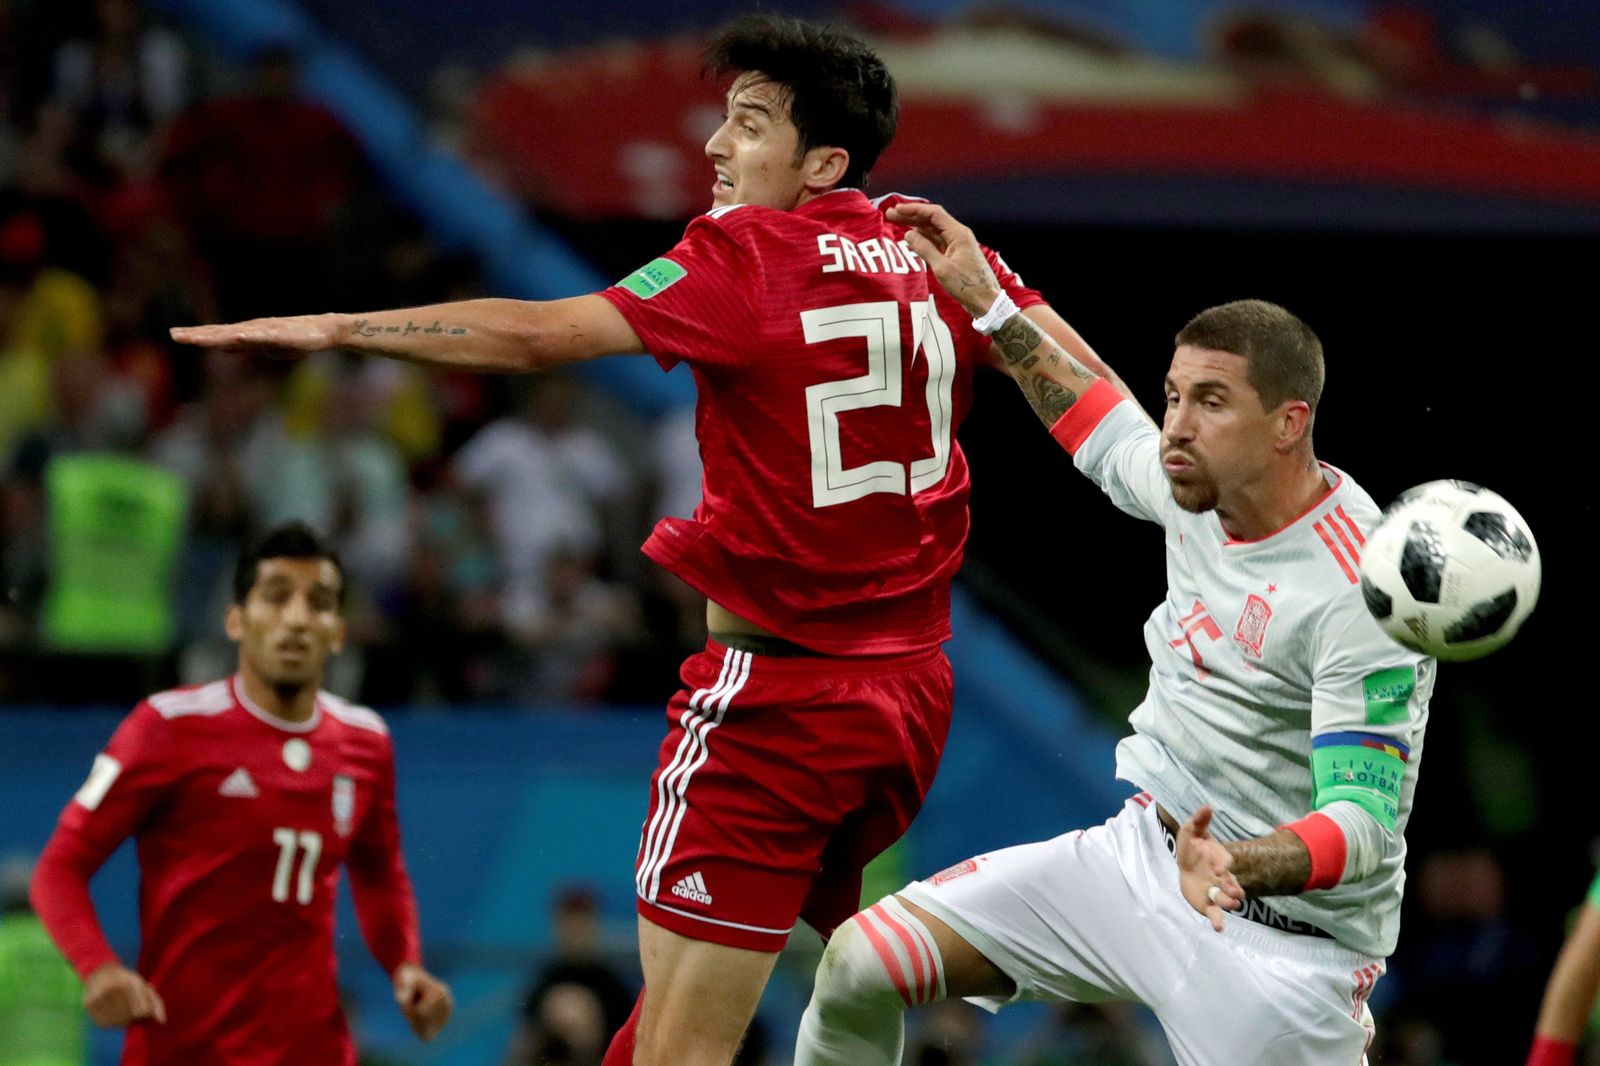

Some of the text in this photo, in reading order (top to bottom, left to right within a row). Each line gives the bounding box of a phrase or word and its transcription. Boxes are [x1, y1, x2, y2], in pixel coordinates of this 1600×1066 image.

[1332, 760, 1399, 781] LIVIN
[1383, 802, 1398, 820] FIF
[272, 827, 323, 905] 11
[671, 885, 712, 905] adidas
